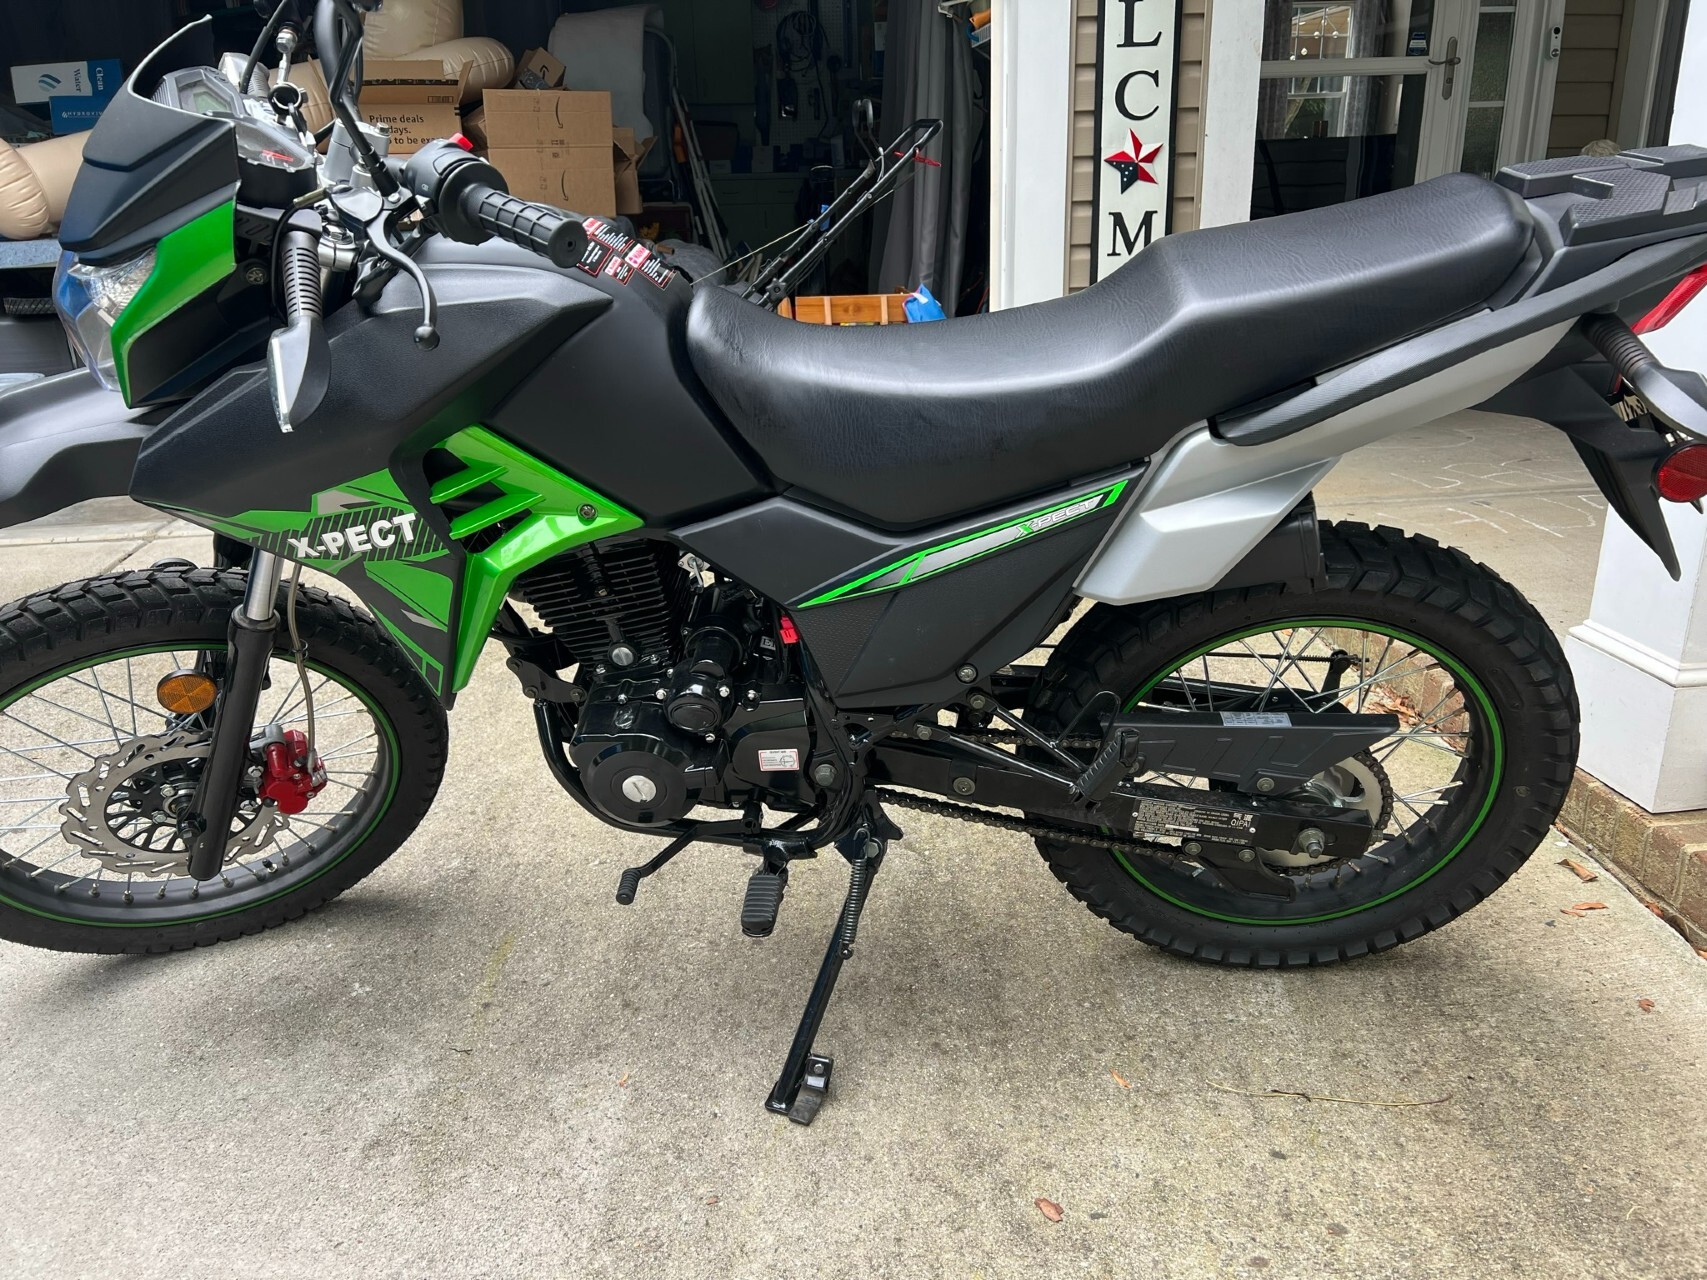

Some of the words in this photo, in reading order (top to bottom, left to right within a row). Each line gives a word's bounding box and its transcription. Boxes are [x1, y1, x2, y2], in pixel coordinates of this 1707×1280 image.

[73, 68, 81, 92] Water
[96, 67, 104, 90] Clean
[369, 114, 398, 123] Prime
[400, 114, 424, 123] deals
[406, 136, 418, 144] be
[1014, 500, 1094, 539] X-PECT
[287, 512, 416, 558] X-PECT
[1230, 819, 1251, 828] QIPAI
